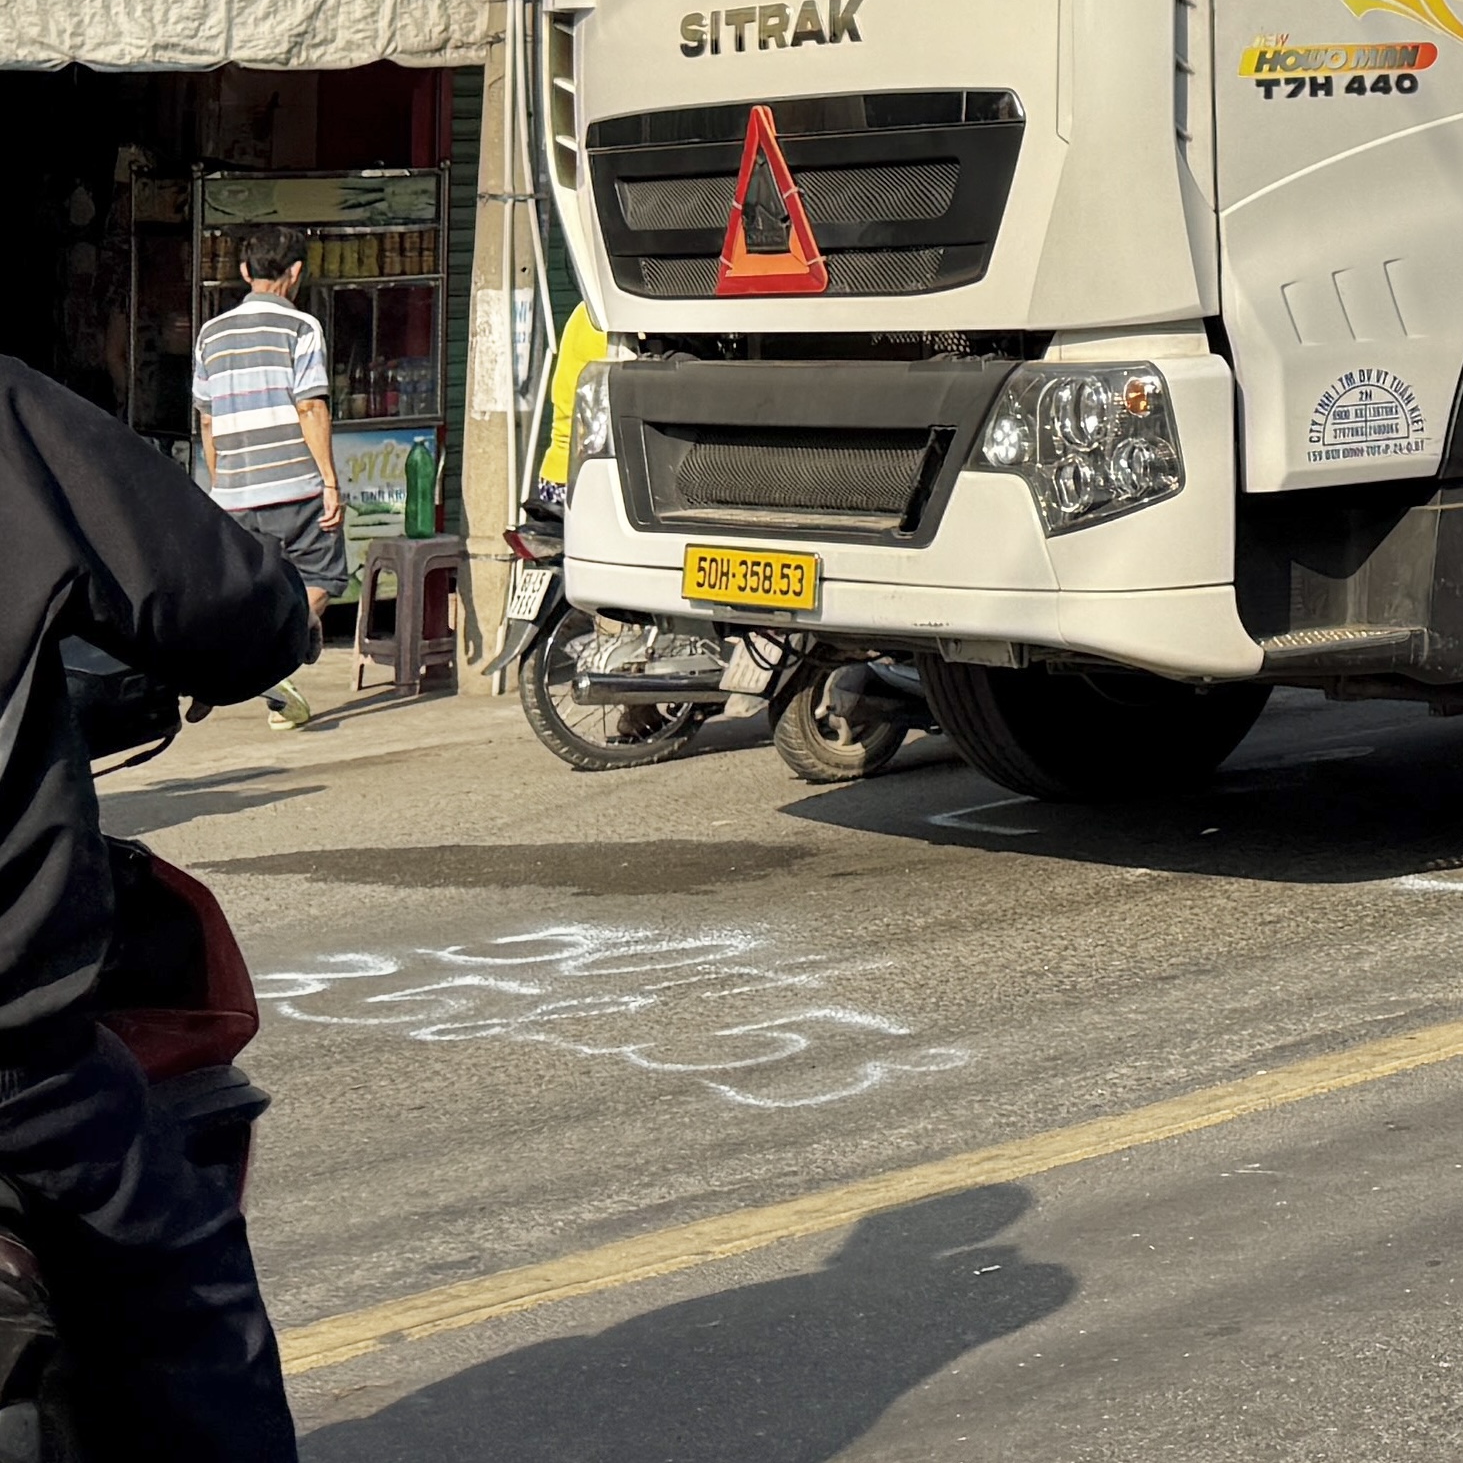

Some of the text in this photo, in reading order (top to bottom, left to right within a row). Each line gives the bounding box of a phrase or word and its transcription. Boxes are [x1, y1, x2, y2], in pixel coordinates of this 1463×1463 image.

[1255, 45, 1420, 73] HOWO MAN
[1255, 73, 1419, 100] T7H 440
